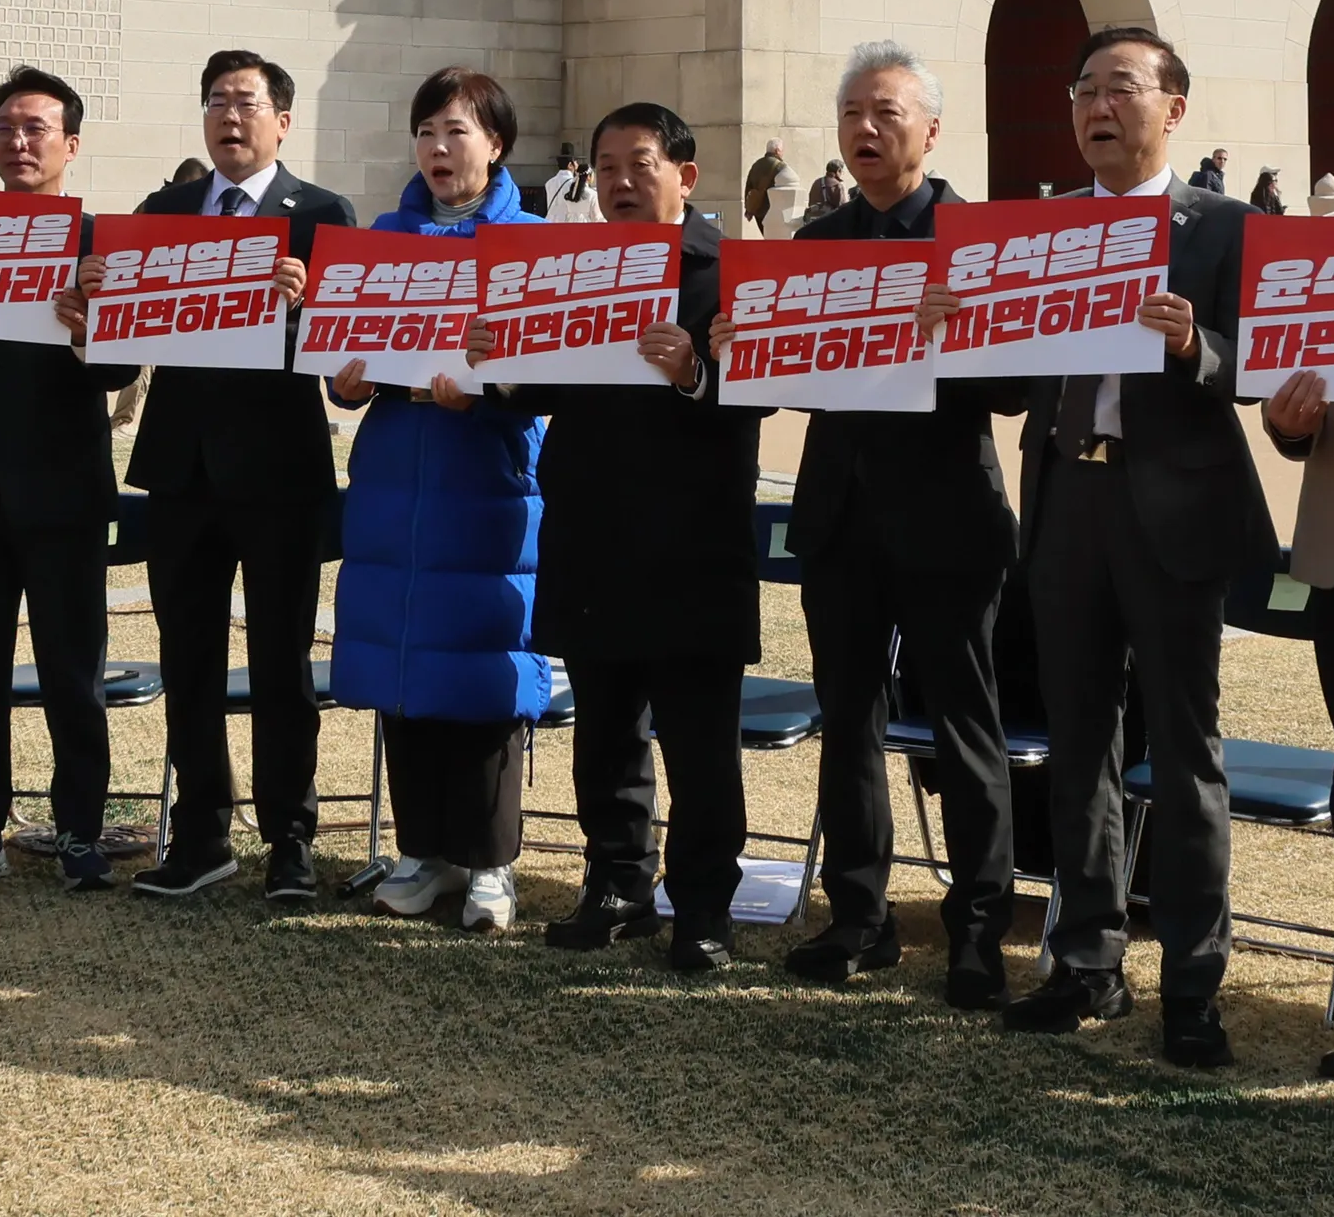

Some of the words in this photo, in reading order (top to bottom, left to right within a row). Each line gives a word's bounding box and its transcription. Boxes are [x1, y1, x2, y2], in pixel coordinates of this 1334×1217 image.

[99, 235, 279, 291] 윤석열을
[485, 242, 670, 307] 윤석열을
[947, 216, 1158, 292] 윤석열을
[92, 286, 280, 342] 파면하라!
[731, 261, 928, 325] 윤석열을
[725, 321, 927, 382] 파면하라!
